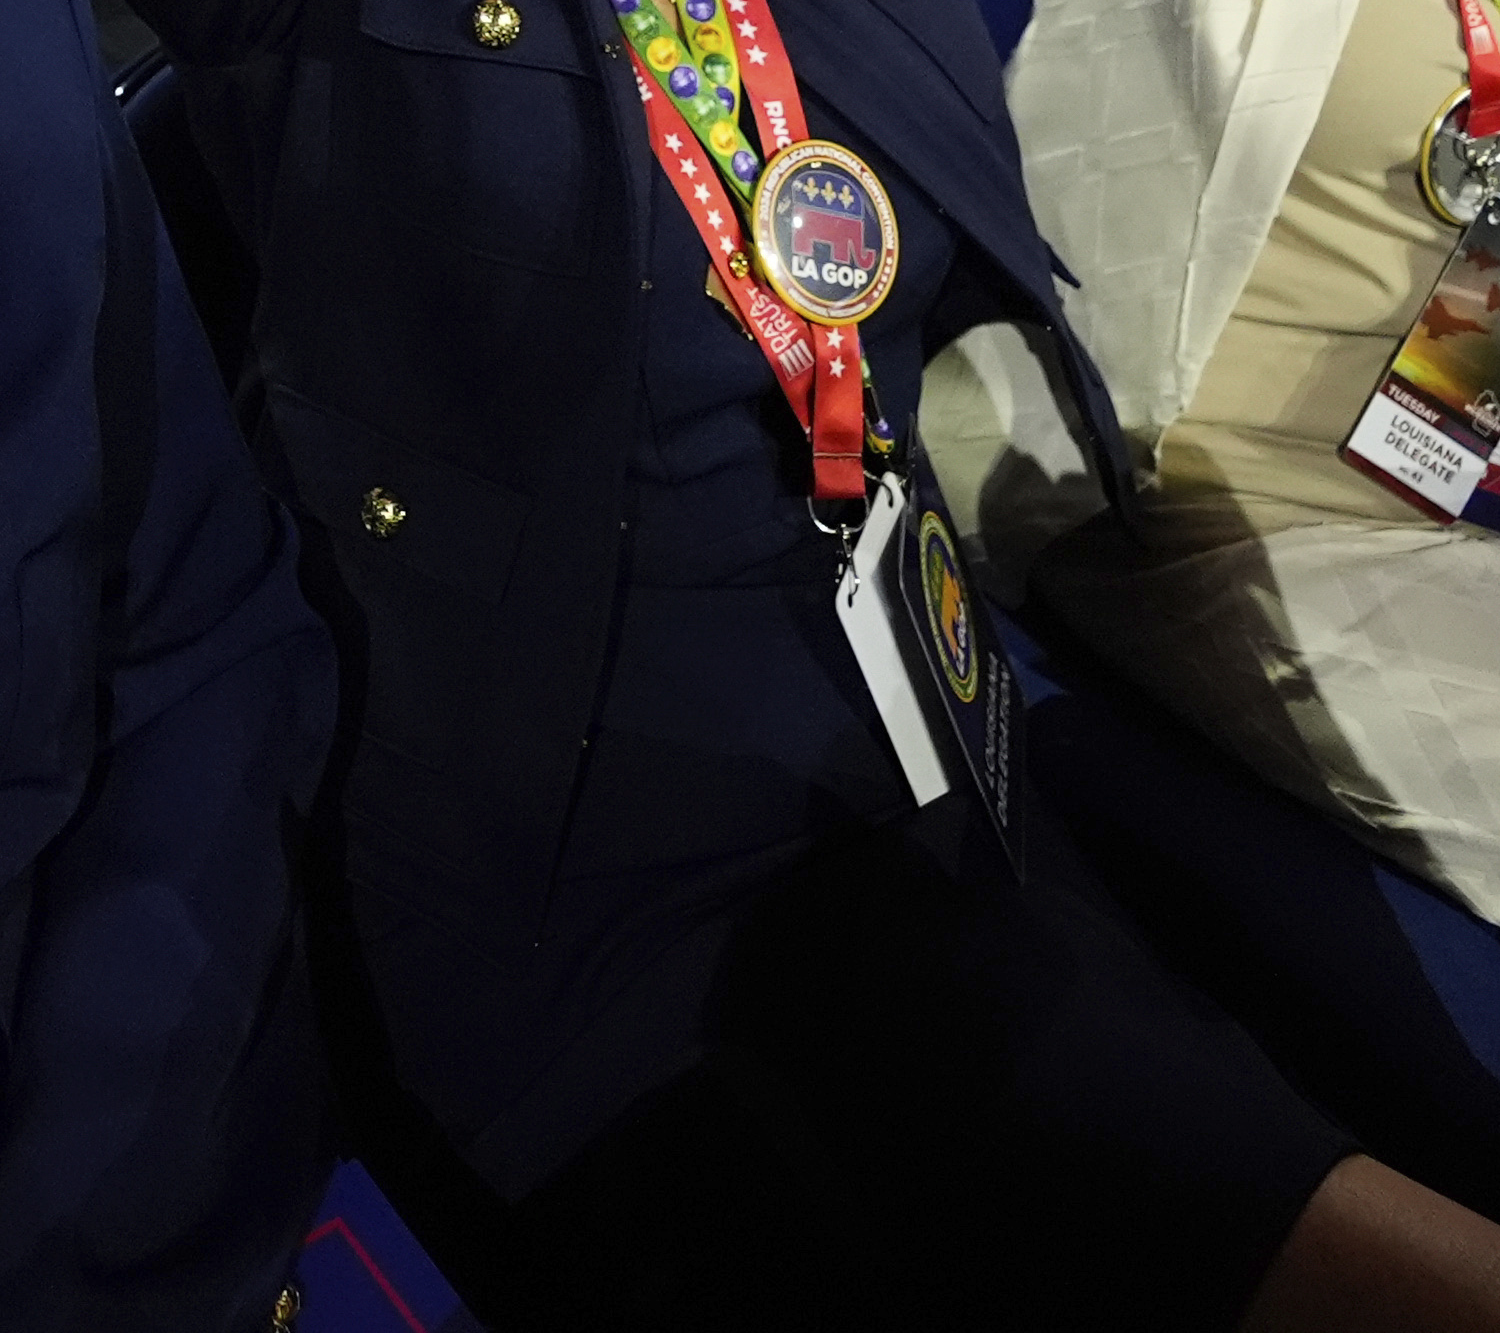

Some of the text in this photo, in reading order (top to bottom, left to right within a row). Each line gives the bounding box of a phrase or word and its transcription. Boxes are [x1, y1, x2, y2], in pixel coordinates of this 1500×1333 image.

[763, 100, 793, 150] RNC
[791, 256, 869, 290] LA GOP
[746, 287, 800, 345] TRUST
[750, 305, 791, 354] DATA
[1387, 385, 1442, 424] TUESDAY
[1384, 431, 1456, 485] DELEGATE
[1390, 414, 1464, 472] LOUISIANA
